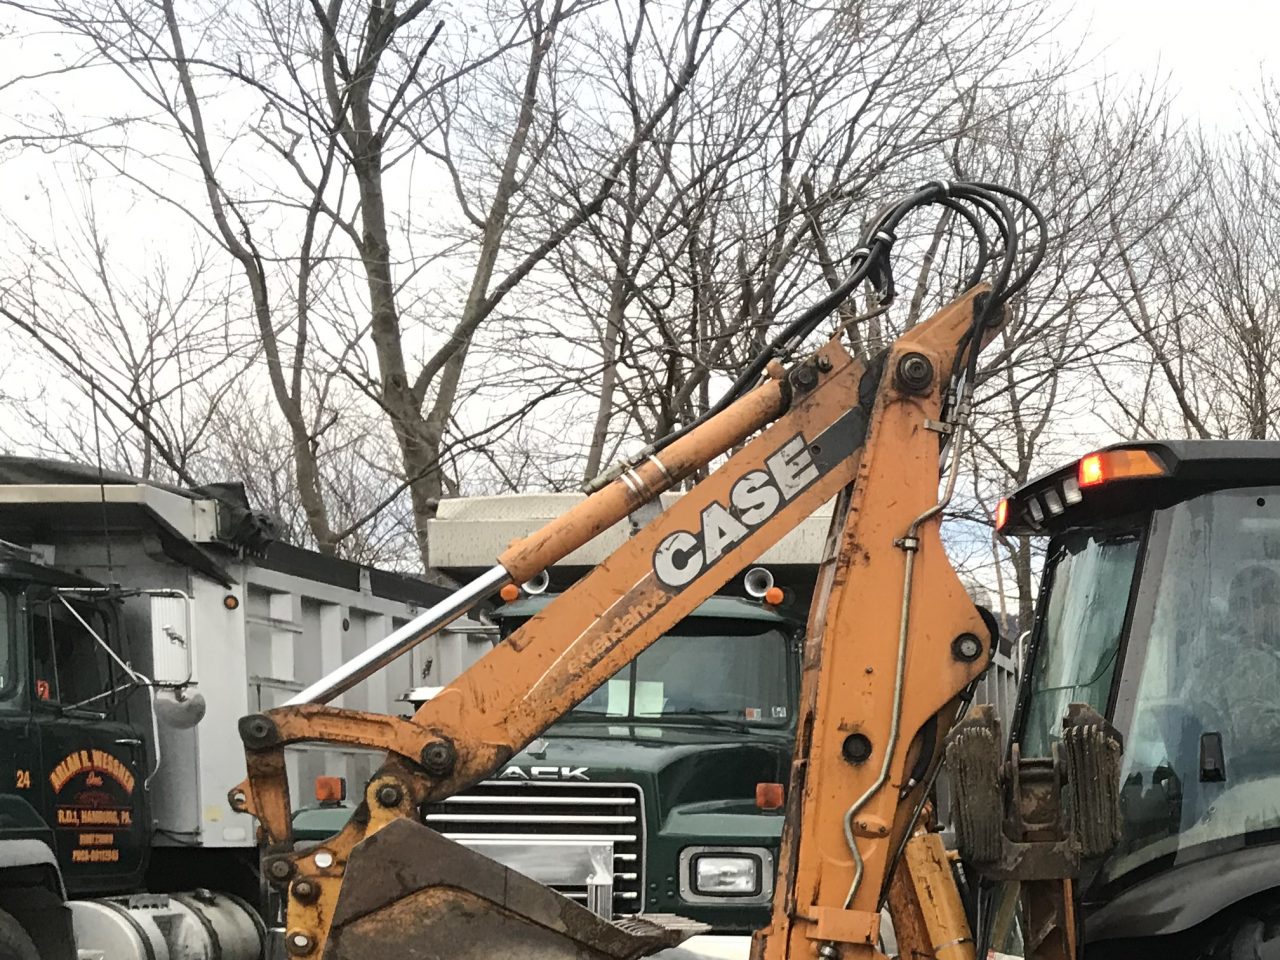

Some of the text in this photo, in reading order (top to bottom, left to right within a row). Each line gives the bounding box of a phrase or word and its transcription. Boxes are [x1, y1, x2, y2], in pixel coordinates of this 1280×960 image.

[653, 433, 820, 587] CASE
[16, 770, 31, 788] 24
[491, 766, 590, 780] ACK
